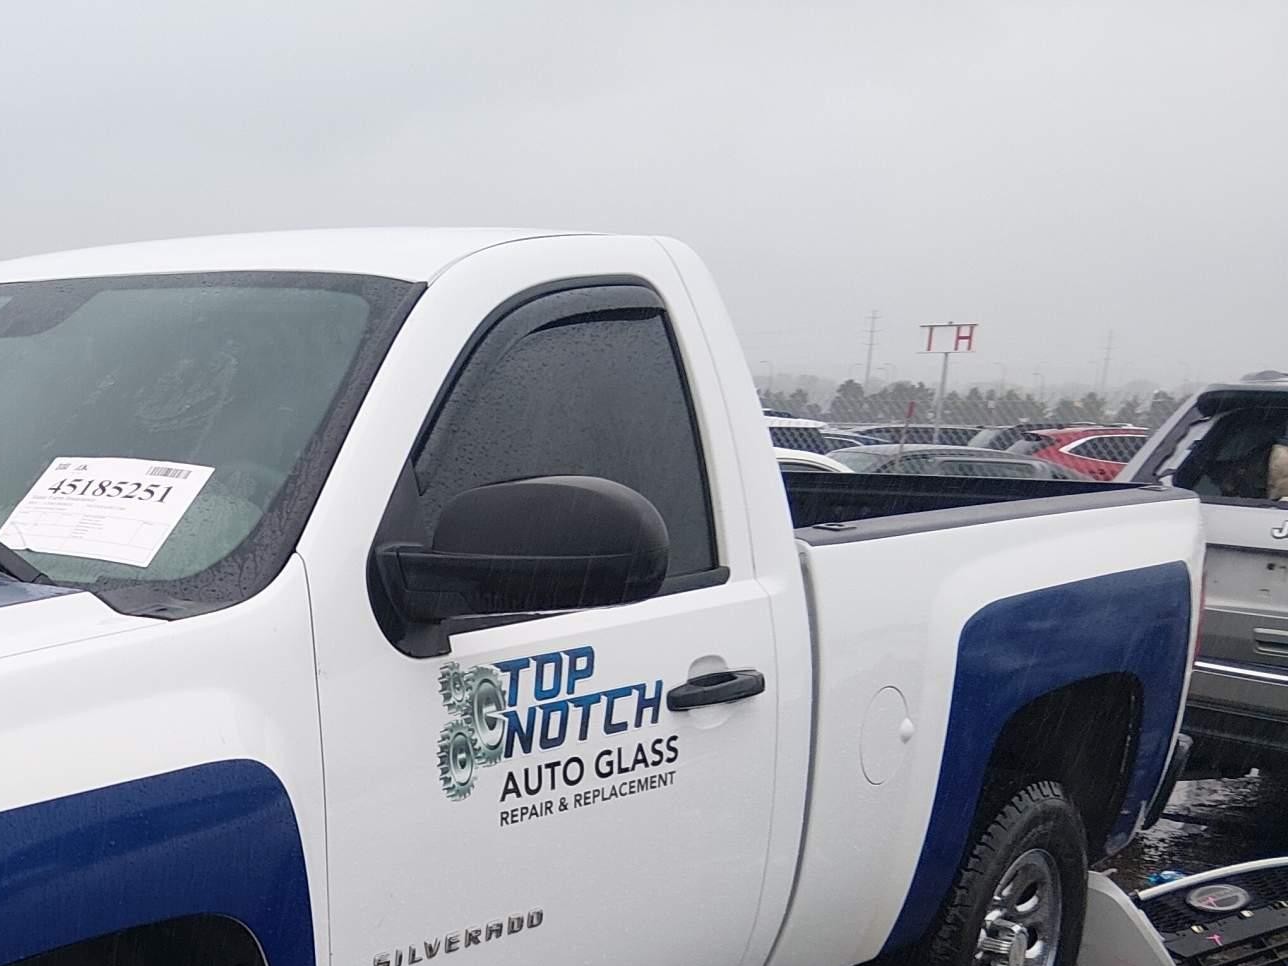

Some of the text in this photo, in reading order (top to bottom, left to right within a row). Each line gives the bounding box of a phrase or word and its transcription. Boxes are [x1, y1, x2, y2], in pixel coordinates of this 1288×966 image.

[48, 478, 173, 503] 45185251
[494, 645, 595, 708] TOP
[502, 680, 663, 759] NOTCH
[499, 734, 680, 802] AUTO GLASS
[499, 771, 677, 827] REPAIR & REPLACEMENT
